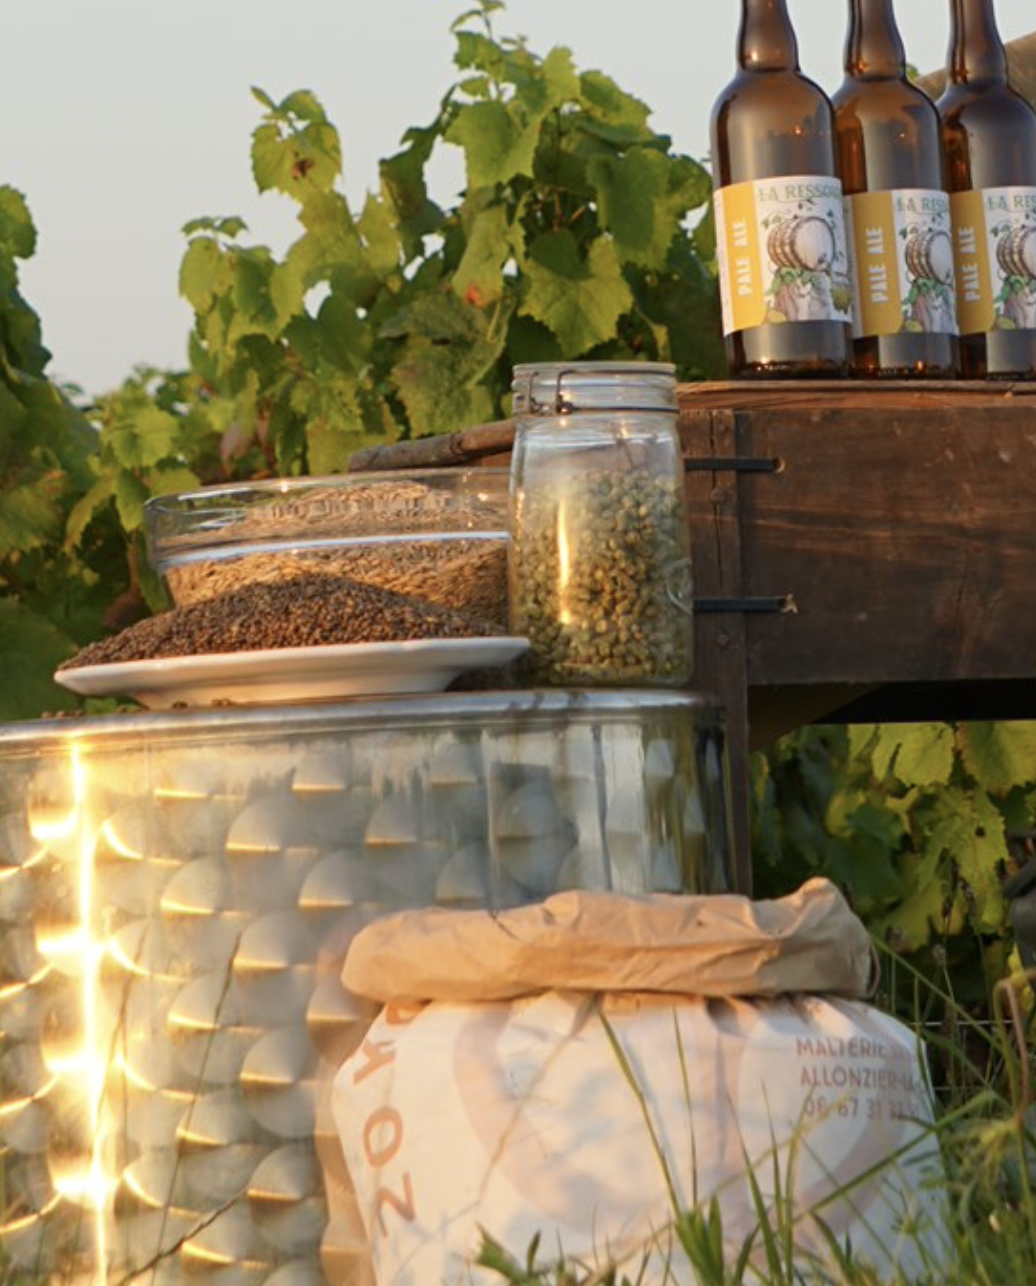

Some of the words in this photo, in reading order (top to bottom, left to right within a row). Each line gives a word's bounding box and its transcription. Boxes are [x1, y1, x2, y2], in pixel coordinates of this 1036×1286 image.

[757, 187, 778, 202] LA
[896, 196, 916, 212] LA
[986, 195, 1008, 210] LA
[731, 218, 749, 248] ALE
[865, 225, 884, 254] ALE
[958, 225, 976, 254] ALE
[735, 257, 753, 297] PALE
[868, 264, 889, 304] PALE
[961, 263, 981, 302] PALE
[796, 1036, 887, 1058] MALTERIE
